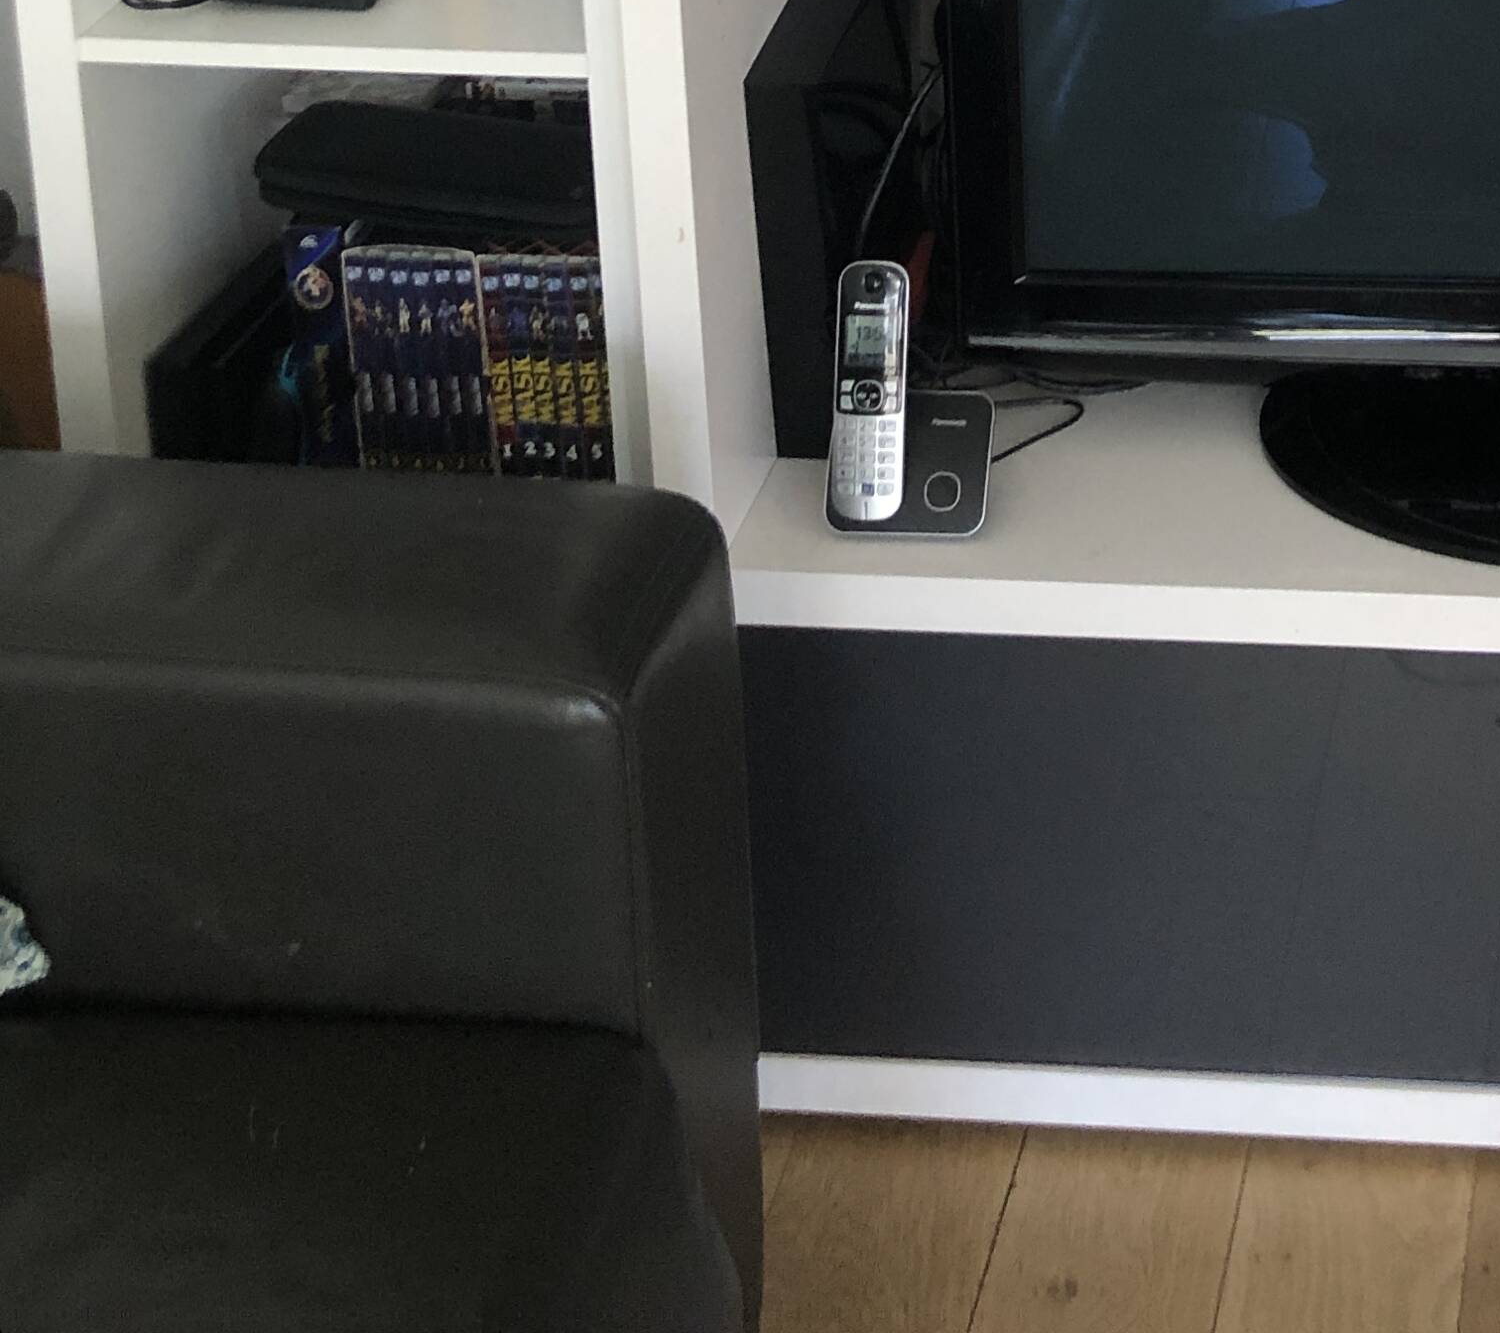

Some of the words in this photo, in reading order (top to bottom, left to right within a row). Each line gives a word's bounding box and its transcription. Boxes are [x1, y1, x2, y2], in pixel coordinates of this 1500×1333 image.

[491, 357, 515, 427] MASK
[512, 355, 538, 425] MASK
[533, 357, 557, 425] MASK
[553, 360, 578, 427] MASK
[502, 442, 513, 459] 1
[524, 440, 538, 458] 2
[543, 441, 557, 460] 3
[566, 444, 579, 462] 4
